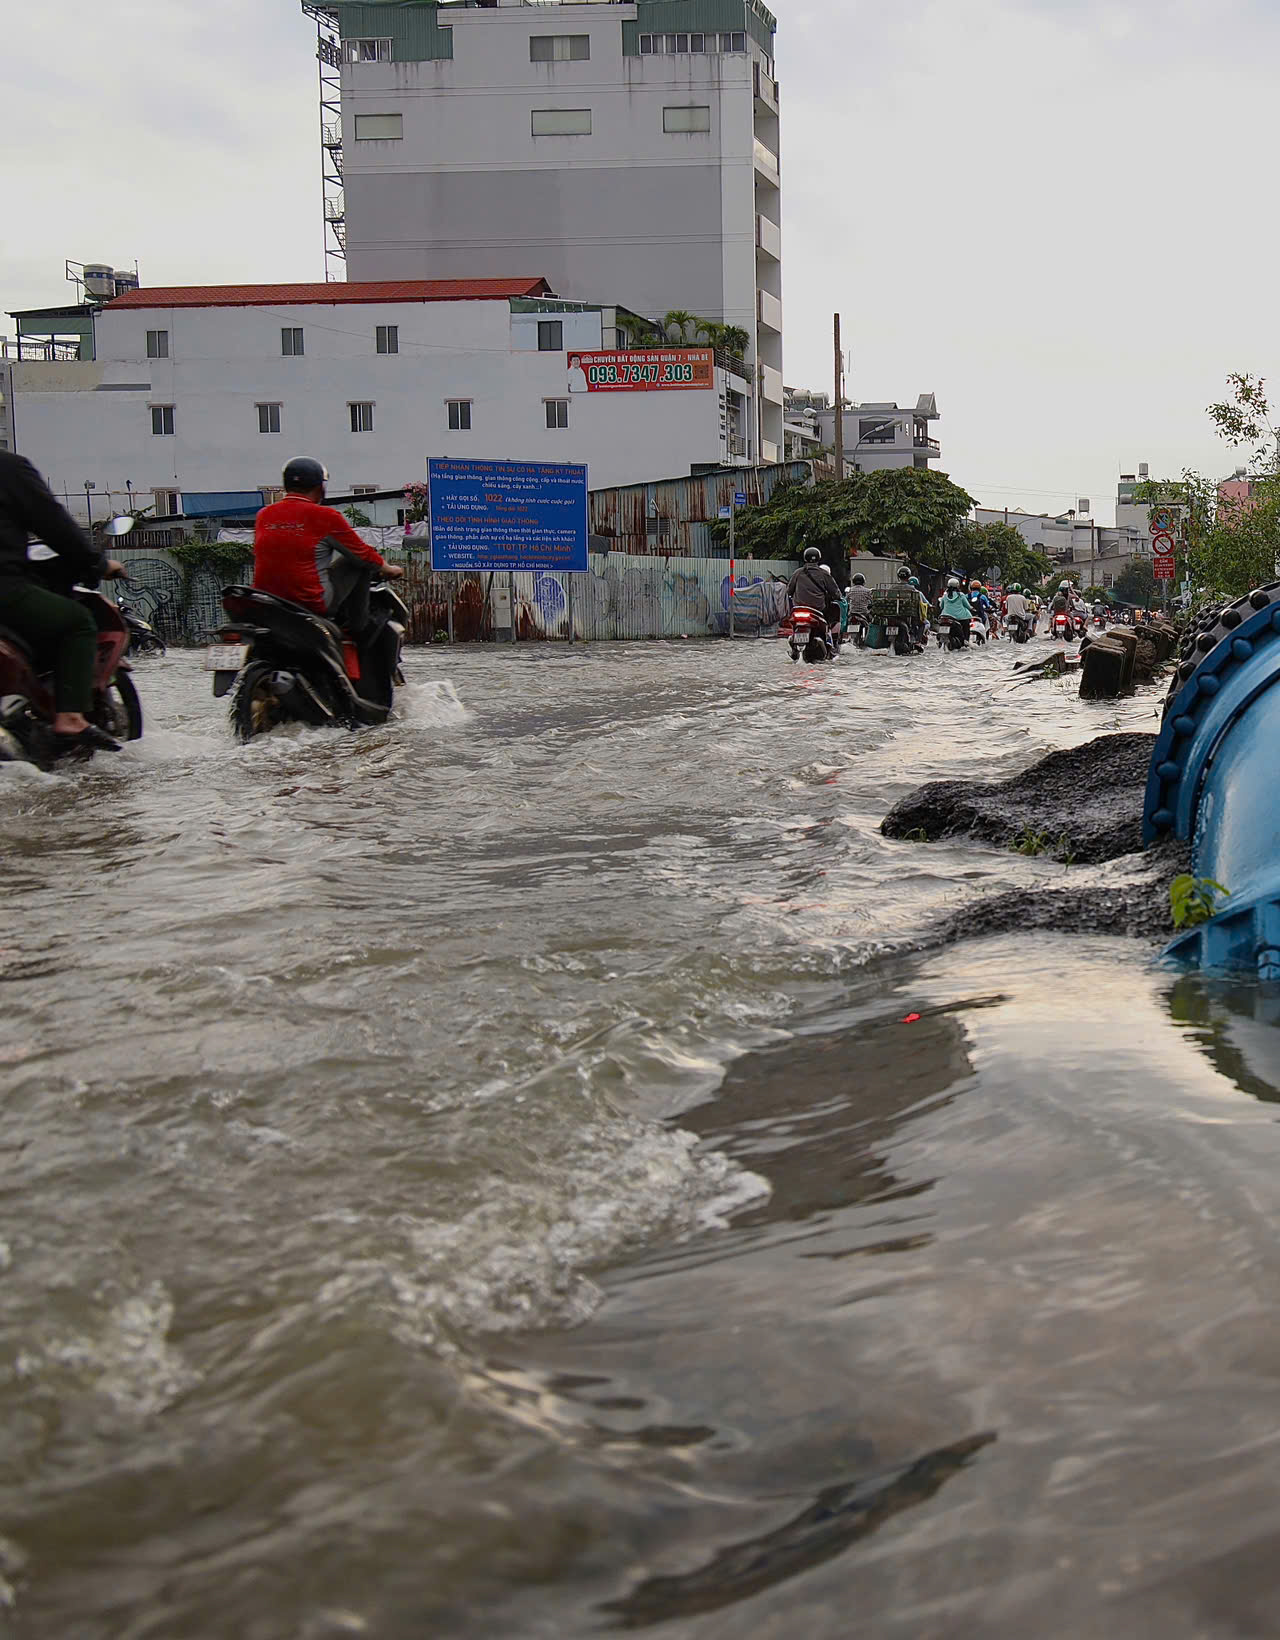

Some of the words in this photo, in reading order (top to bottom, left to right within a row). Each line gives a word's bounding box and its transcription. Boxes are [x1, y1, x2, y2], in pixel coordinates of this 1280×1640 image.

[646, 353, 659, 362] SẢN
[589, 364, 692, 383] 093.7347.303
[484, 493, 503, 503] 1022
